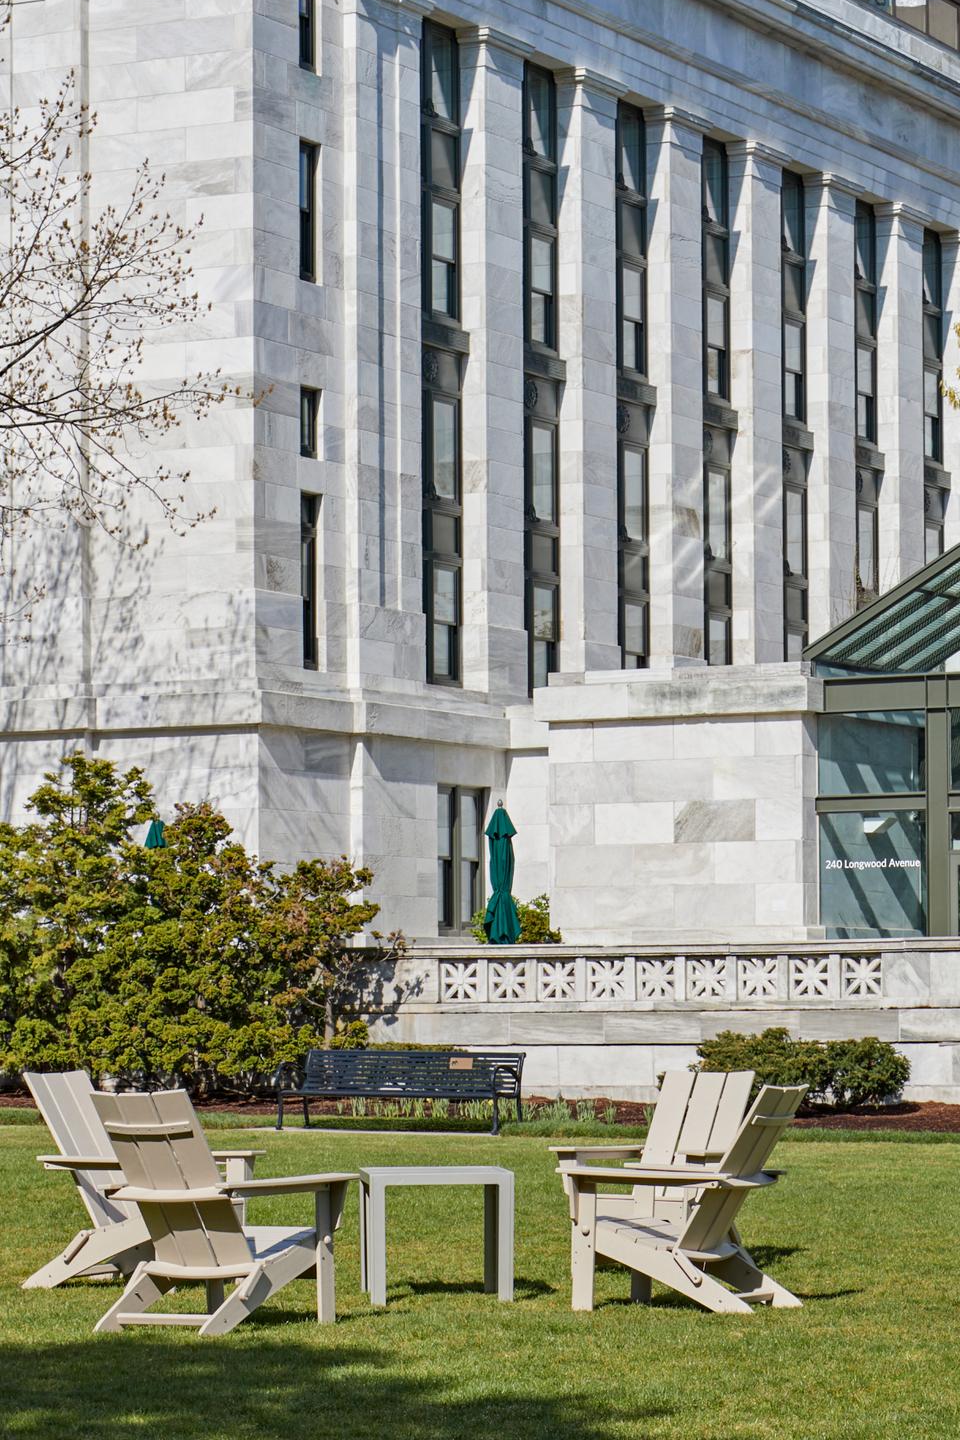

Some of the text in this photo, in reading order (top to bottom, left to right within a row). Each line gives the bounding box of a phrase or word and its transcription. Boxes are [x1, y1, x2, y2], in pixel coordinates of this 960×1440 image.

[825, 859, 920, 870] 240 Longwood Avenue
